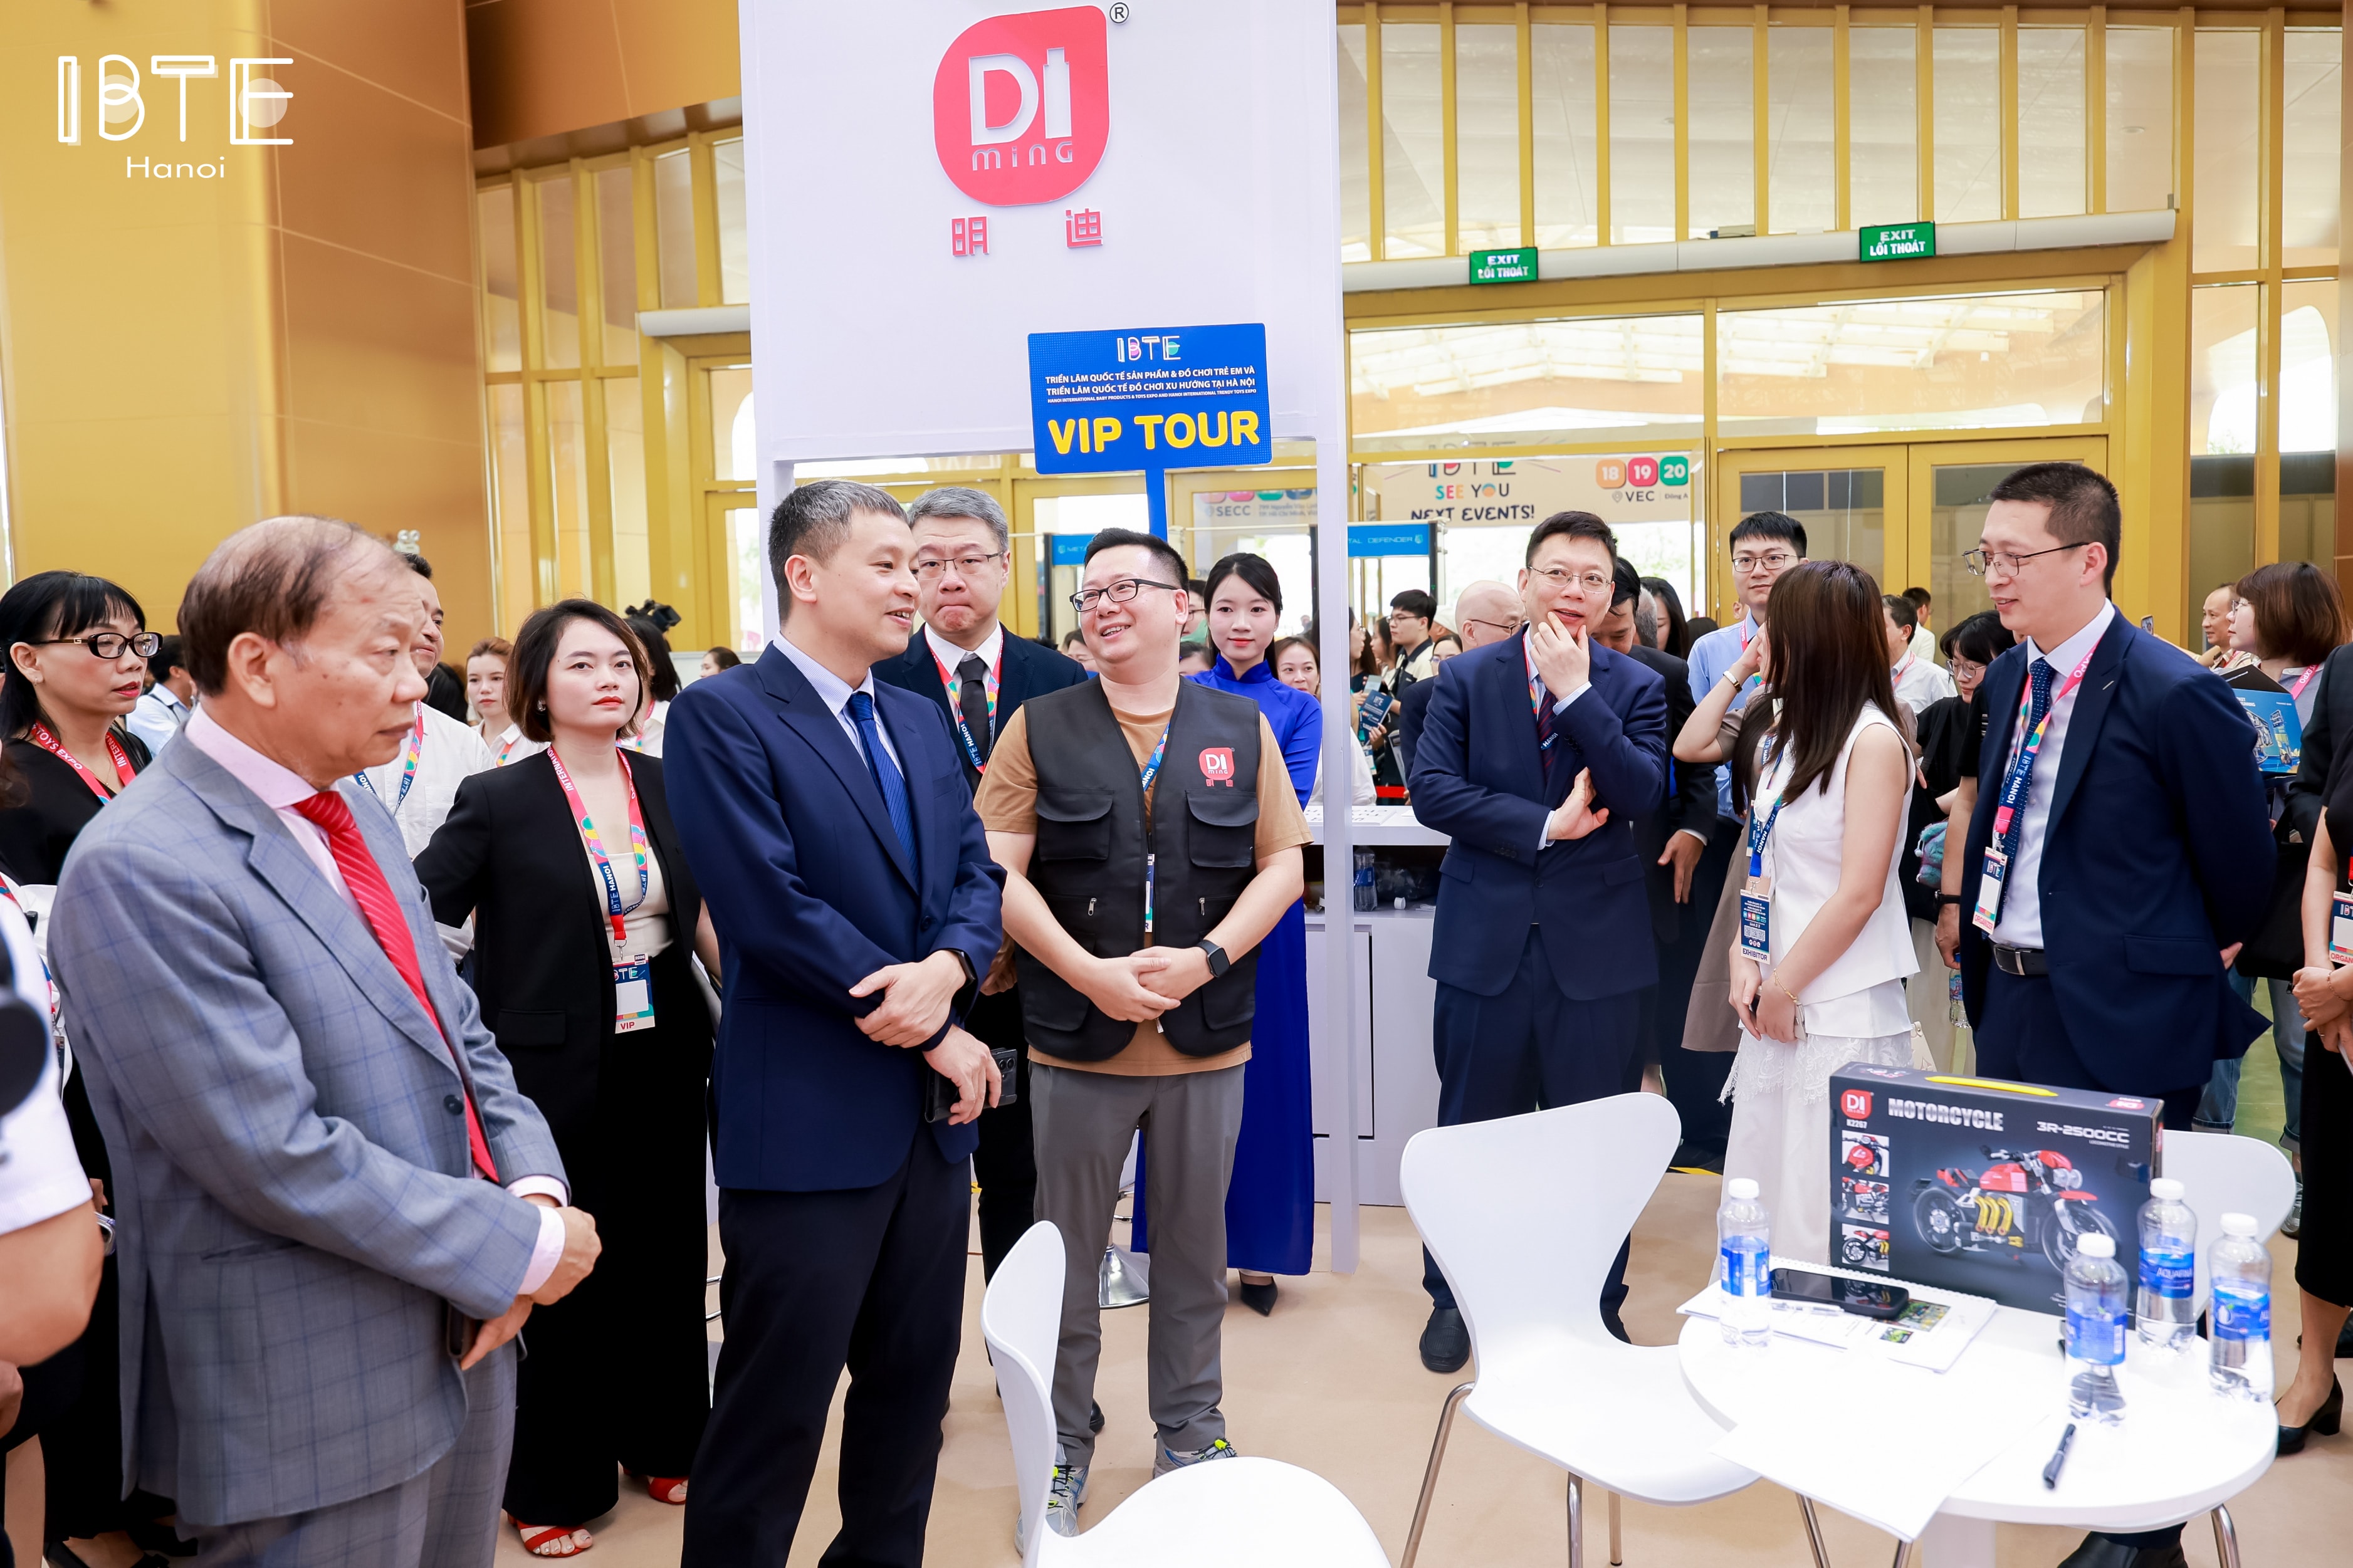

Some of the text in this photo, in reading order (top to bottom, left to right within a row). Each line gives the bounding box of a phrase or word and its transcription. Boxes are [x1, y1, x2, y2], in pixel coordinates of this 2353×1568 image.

[968, 46, 1072, 146] DI
[1880, 229, 1915, 241] EXIT
[1890, 239, 1926, 254] THOÁT
[1487, 254, 1520, 265] EXIT
[1497, 264, 1529, 278] THOÁT
[1117, 335, 1181, 363] IBTE
[1071, 374, 1088, 383] LÃM
[1090, 372, 1114, 382] QUỐC
[1115, 371, 1125, 380] TẾ
[1072, 385, 1090, 394] LÃM
[1092, 384, 1116, 394] QUỐC
[1117, 383, 1128, 392] TẾ
[1143, 382, 1164, 390] CHƠI
[1179, 380, 1210, 389] HƯỚNG
[1212, 380, 1224, 389] TẠI
[1226, 379, 1238, 387] HÀ
[1240, 377, 1255, 387] NỘI
[1048, 410, 1260, 454] VIP TOUR
[1601, 466, 1620, 481] 18
[1633, 464, 1652, 480] 19
[1664, 464, 1685, 478] 20
[1435, 483, 1509, 500] SEE YOU
[1625, 491, 1655, 502] VEC
[1217, 505, 1251, 517] SECC
[1411, 504, 1535, 522] NEXT EVENTS!
[2299, 668, 2313, 684] EXPO
[37, 728, 59, 750] TOYS
[960, 723, 974, 747] HANOI
[1543, 733, 1558, 747] HANOI
[56, 749, 83, 770] EXPO
[1205, 754, 1227, 770] DI
[1142, 768, 1155, 787] ANOI
[2006, 756, 2031, 803] IBTE HANOI
[1757, 830, 1768, 854] HANOI
[603, 865, 620, 912] IBTE HANOI
[1742, 948, 1768, 961] EXHIBITOR
[2330, 953, 2353, 963] ORGAN
[614, 967, 638, 981] BTE
[621, 1022, 634, 1030] VIP
[1847, 1094, 1865, 1111] DI
[1889, 1098, 2004, 1131] MOTORCYCLE
[2036, 1121, 2130, 1144] 3R-2500CC
